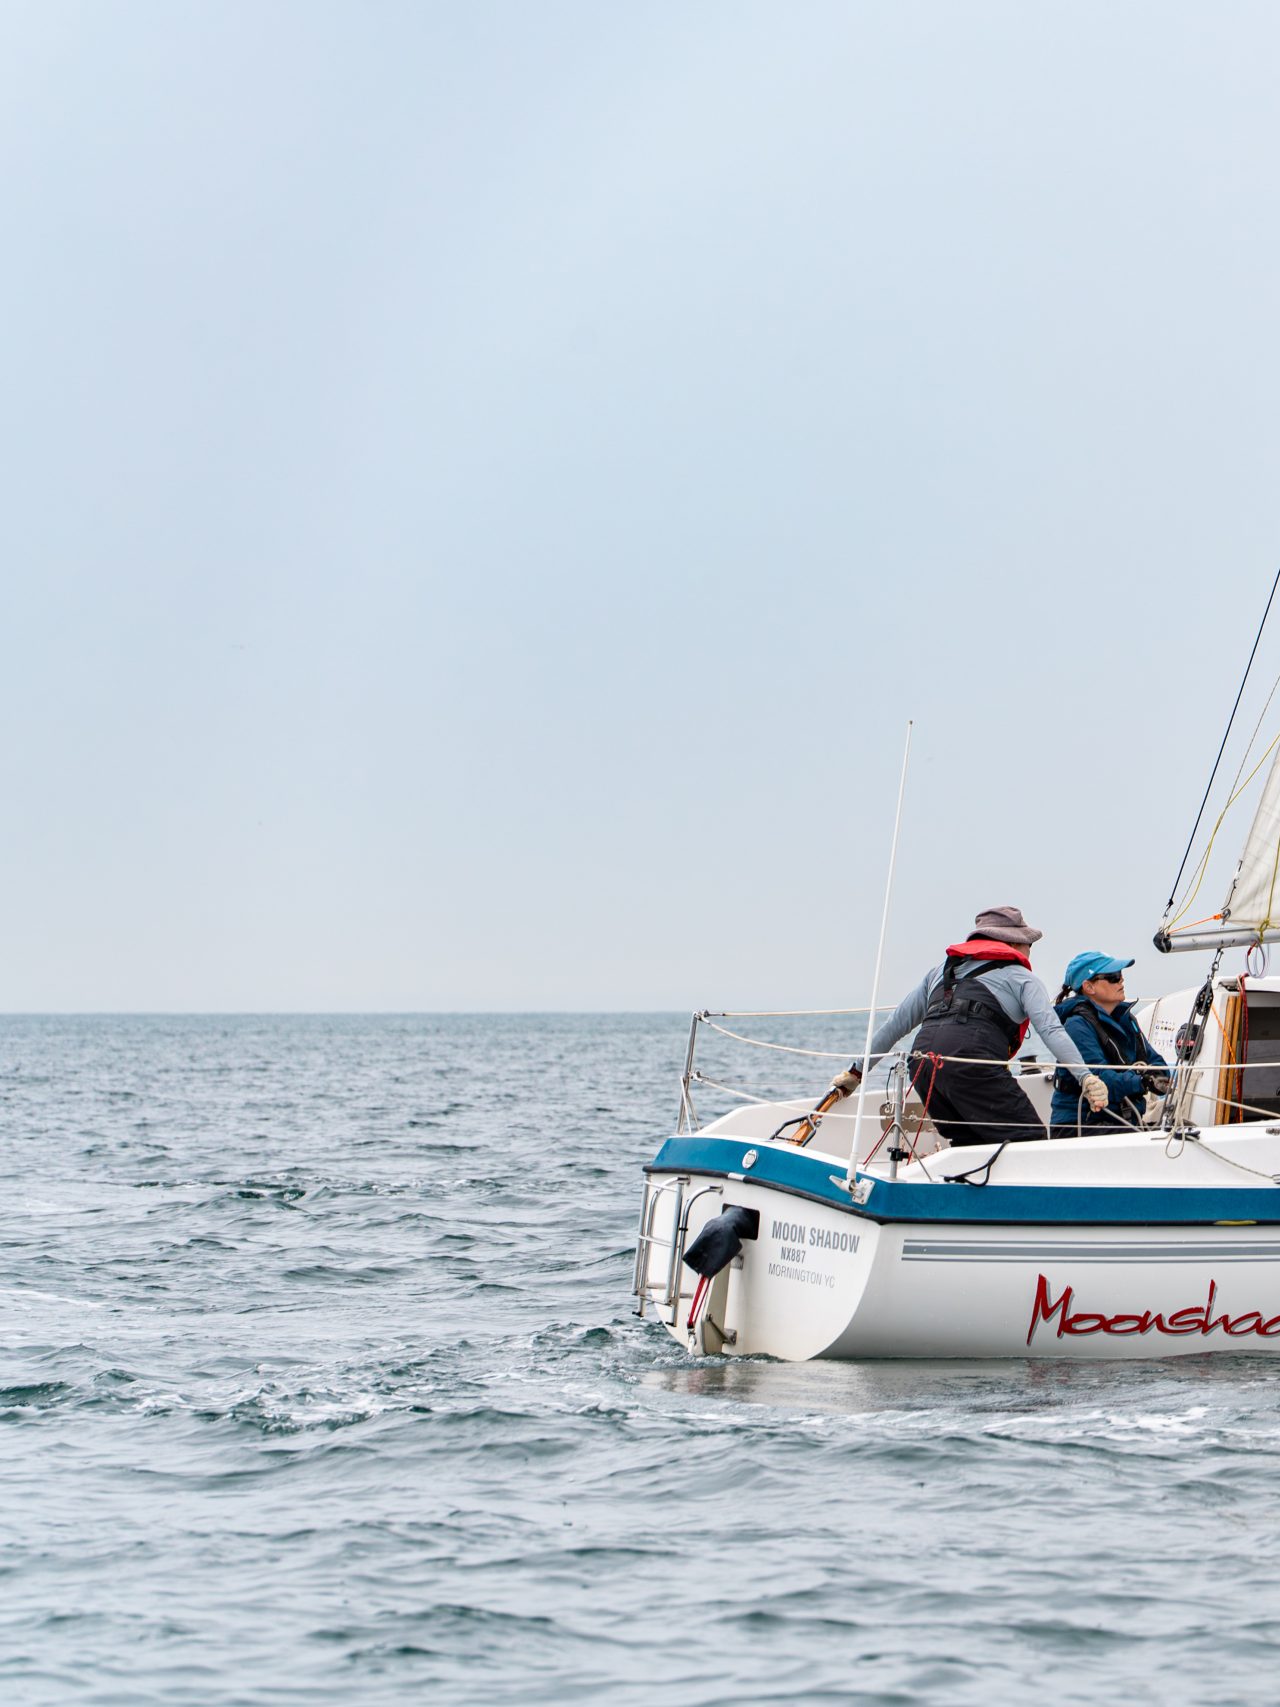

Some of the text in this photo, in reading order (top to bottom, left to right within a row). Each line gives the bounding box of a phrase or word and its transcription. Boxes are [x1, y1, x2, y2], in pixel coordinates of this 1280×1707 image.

[772, 1220, 860, 1253] MOON SHADOW
[780, 1246, 806, 1264] NX887
[768, 1263, 836, 1288] MORNINGTON YC
